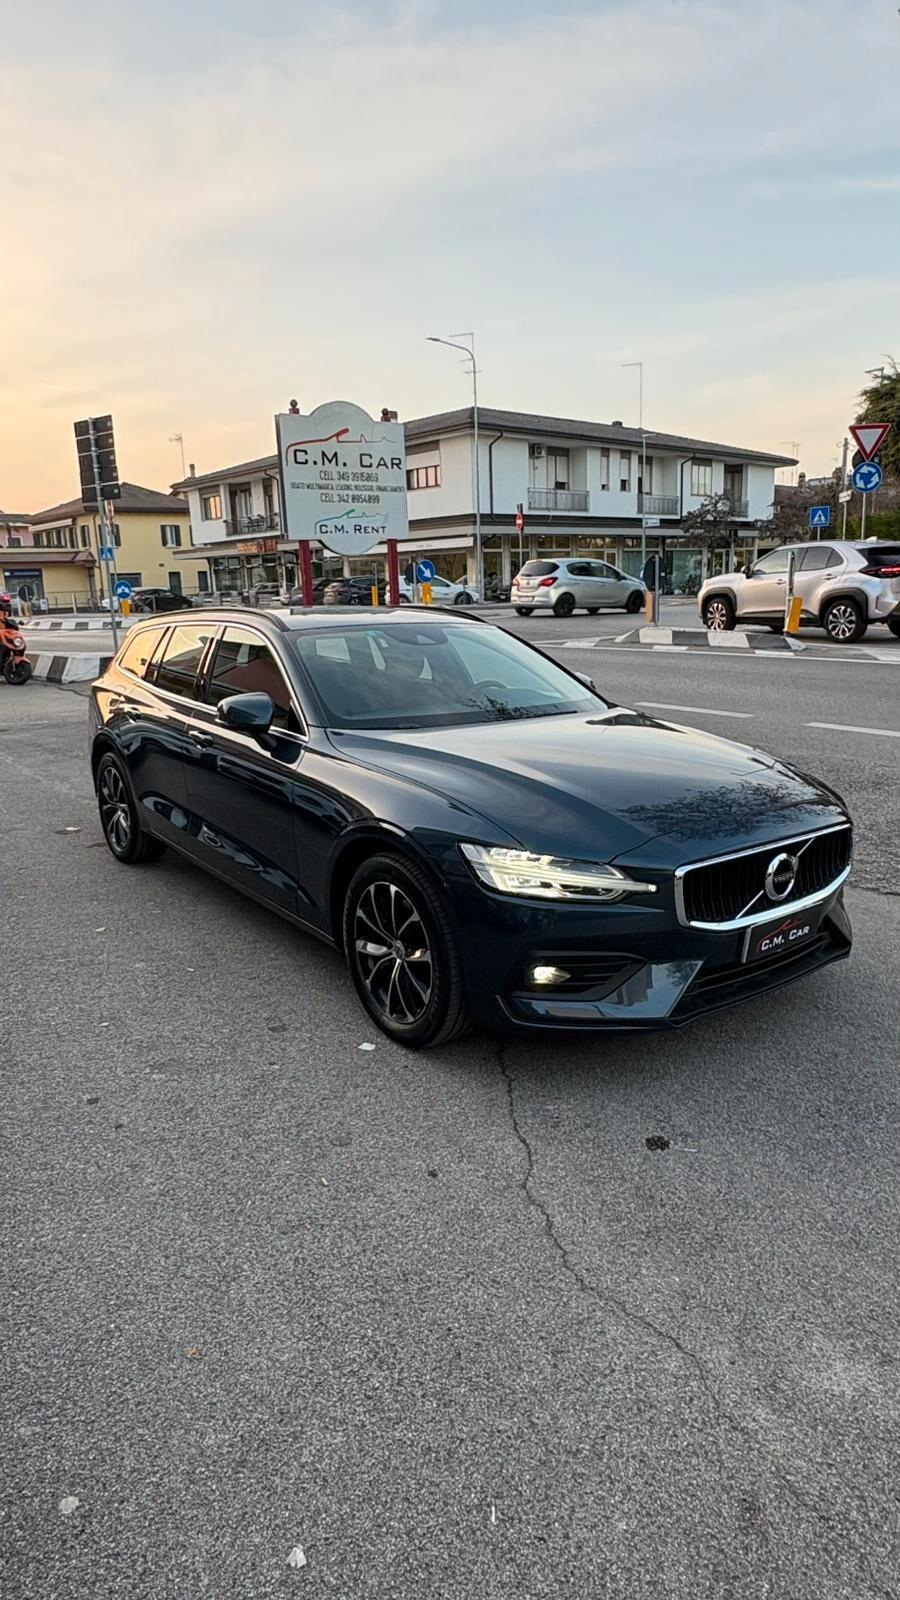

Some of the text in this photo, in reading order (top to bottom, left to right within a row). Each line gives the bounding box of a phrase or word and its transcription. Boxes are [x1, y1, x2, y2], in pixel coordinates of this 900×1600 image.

[293, 449, 347, 467] C.M.
[336, 470, 350, 482] 349
[336, 493, 350, 504] 342
[319, 524, 349, 534] C.M.
[761, 934, 785, 951] C.M.
